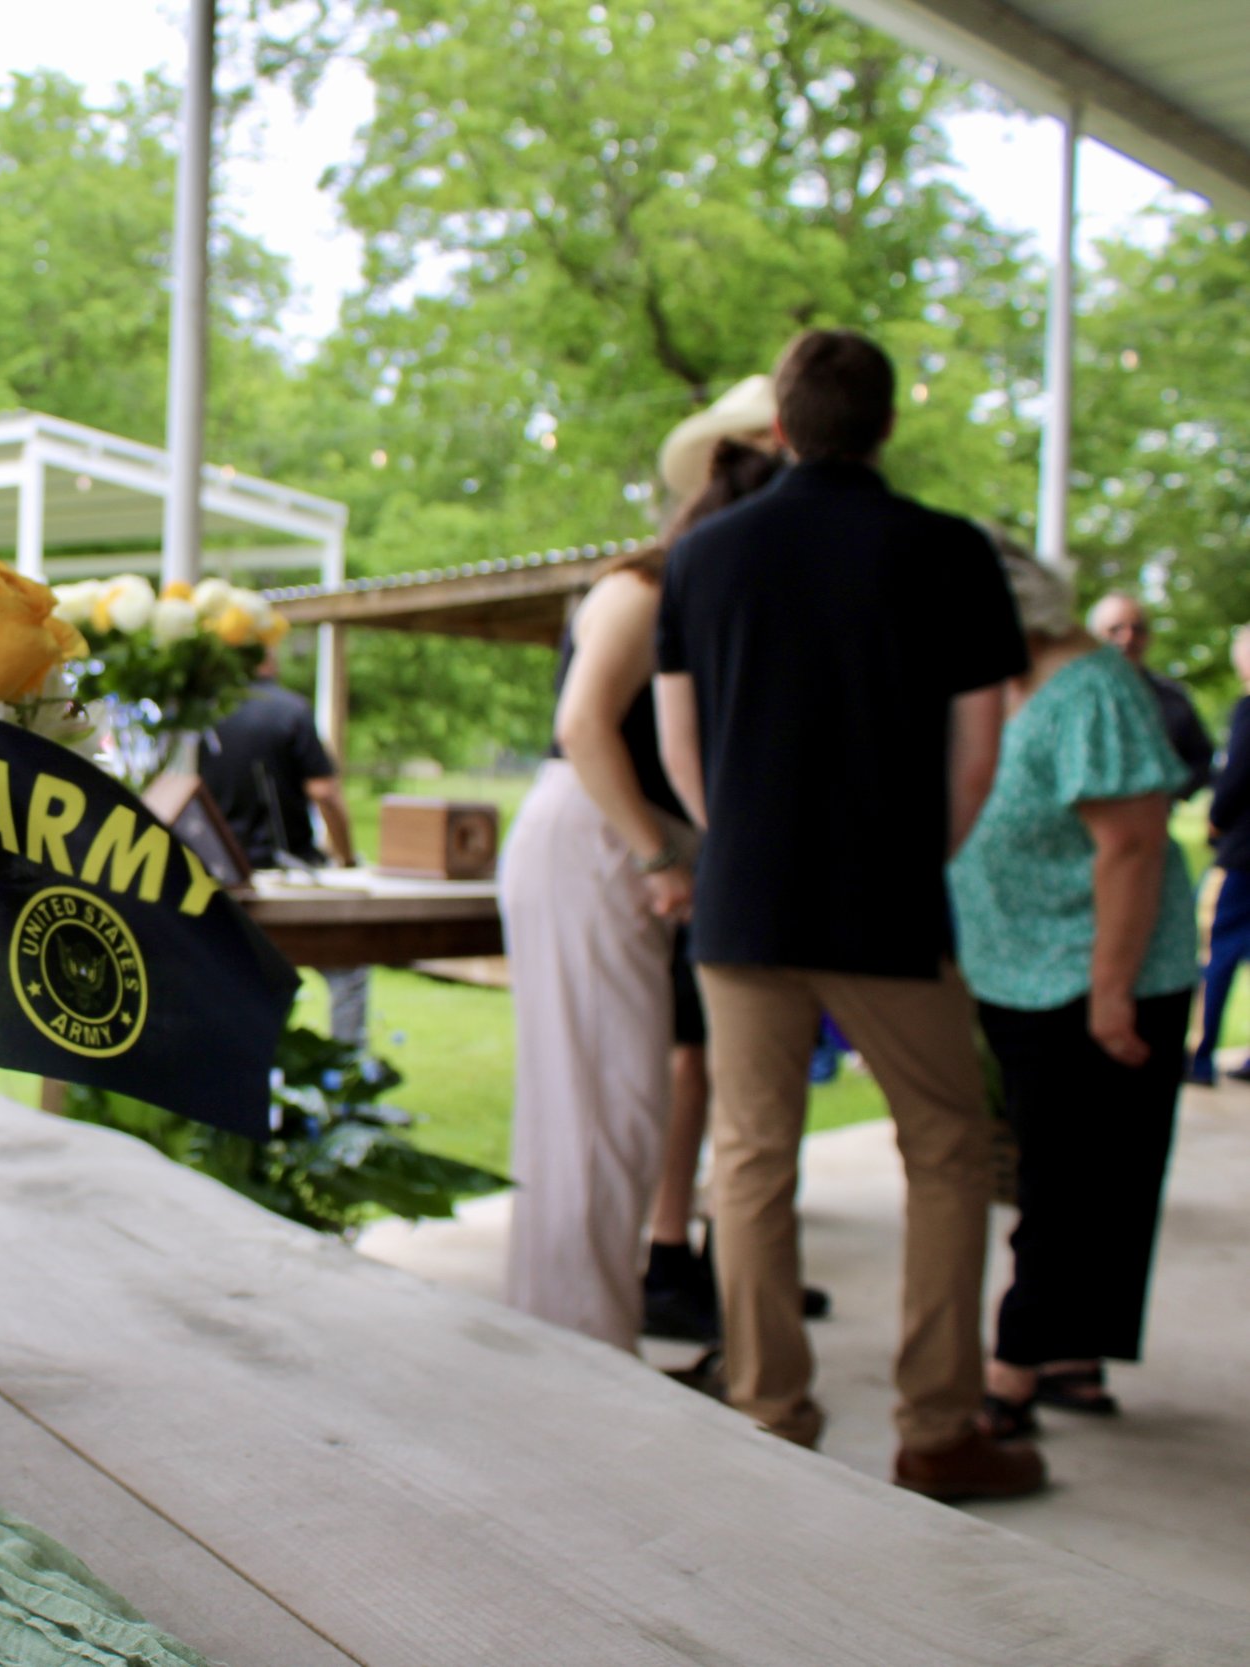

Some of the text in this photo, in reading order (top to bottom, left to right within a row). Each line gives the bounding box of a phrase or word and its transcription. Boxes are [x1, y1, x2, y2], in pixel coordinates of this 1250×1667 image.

[21, 896, 140, 993] UNITED STATES
[49, 1012, 113, 1046] ARMY
